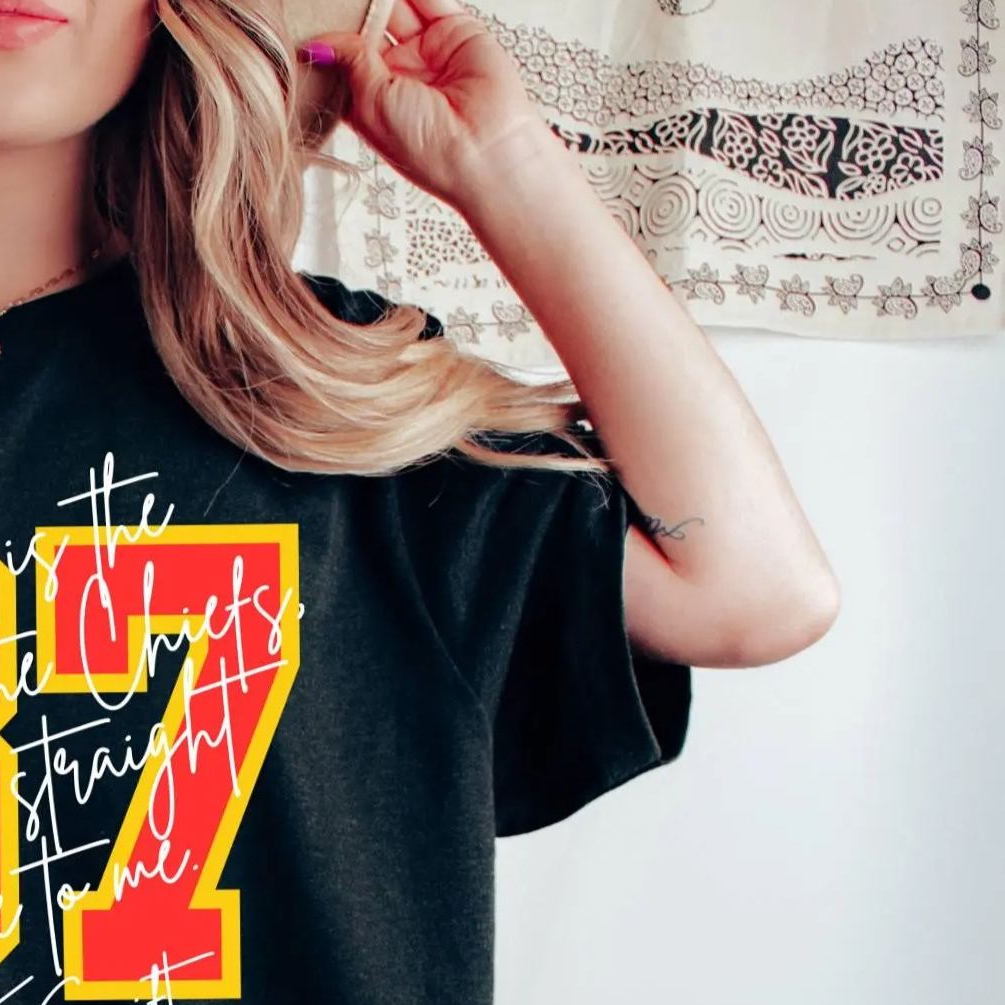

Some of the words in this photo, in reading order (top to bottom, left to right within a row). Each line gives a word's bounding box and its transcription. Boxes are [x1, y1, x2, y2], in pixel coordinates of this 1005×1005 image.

[4, 534, 71, 602] is
[57, 451, 175, 642] the
[9, 656, 289, 856] straight
[9, 835, 112, 977] to
[113, 838, 200, 902] me.
